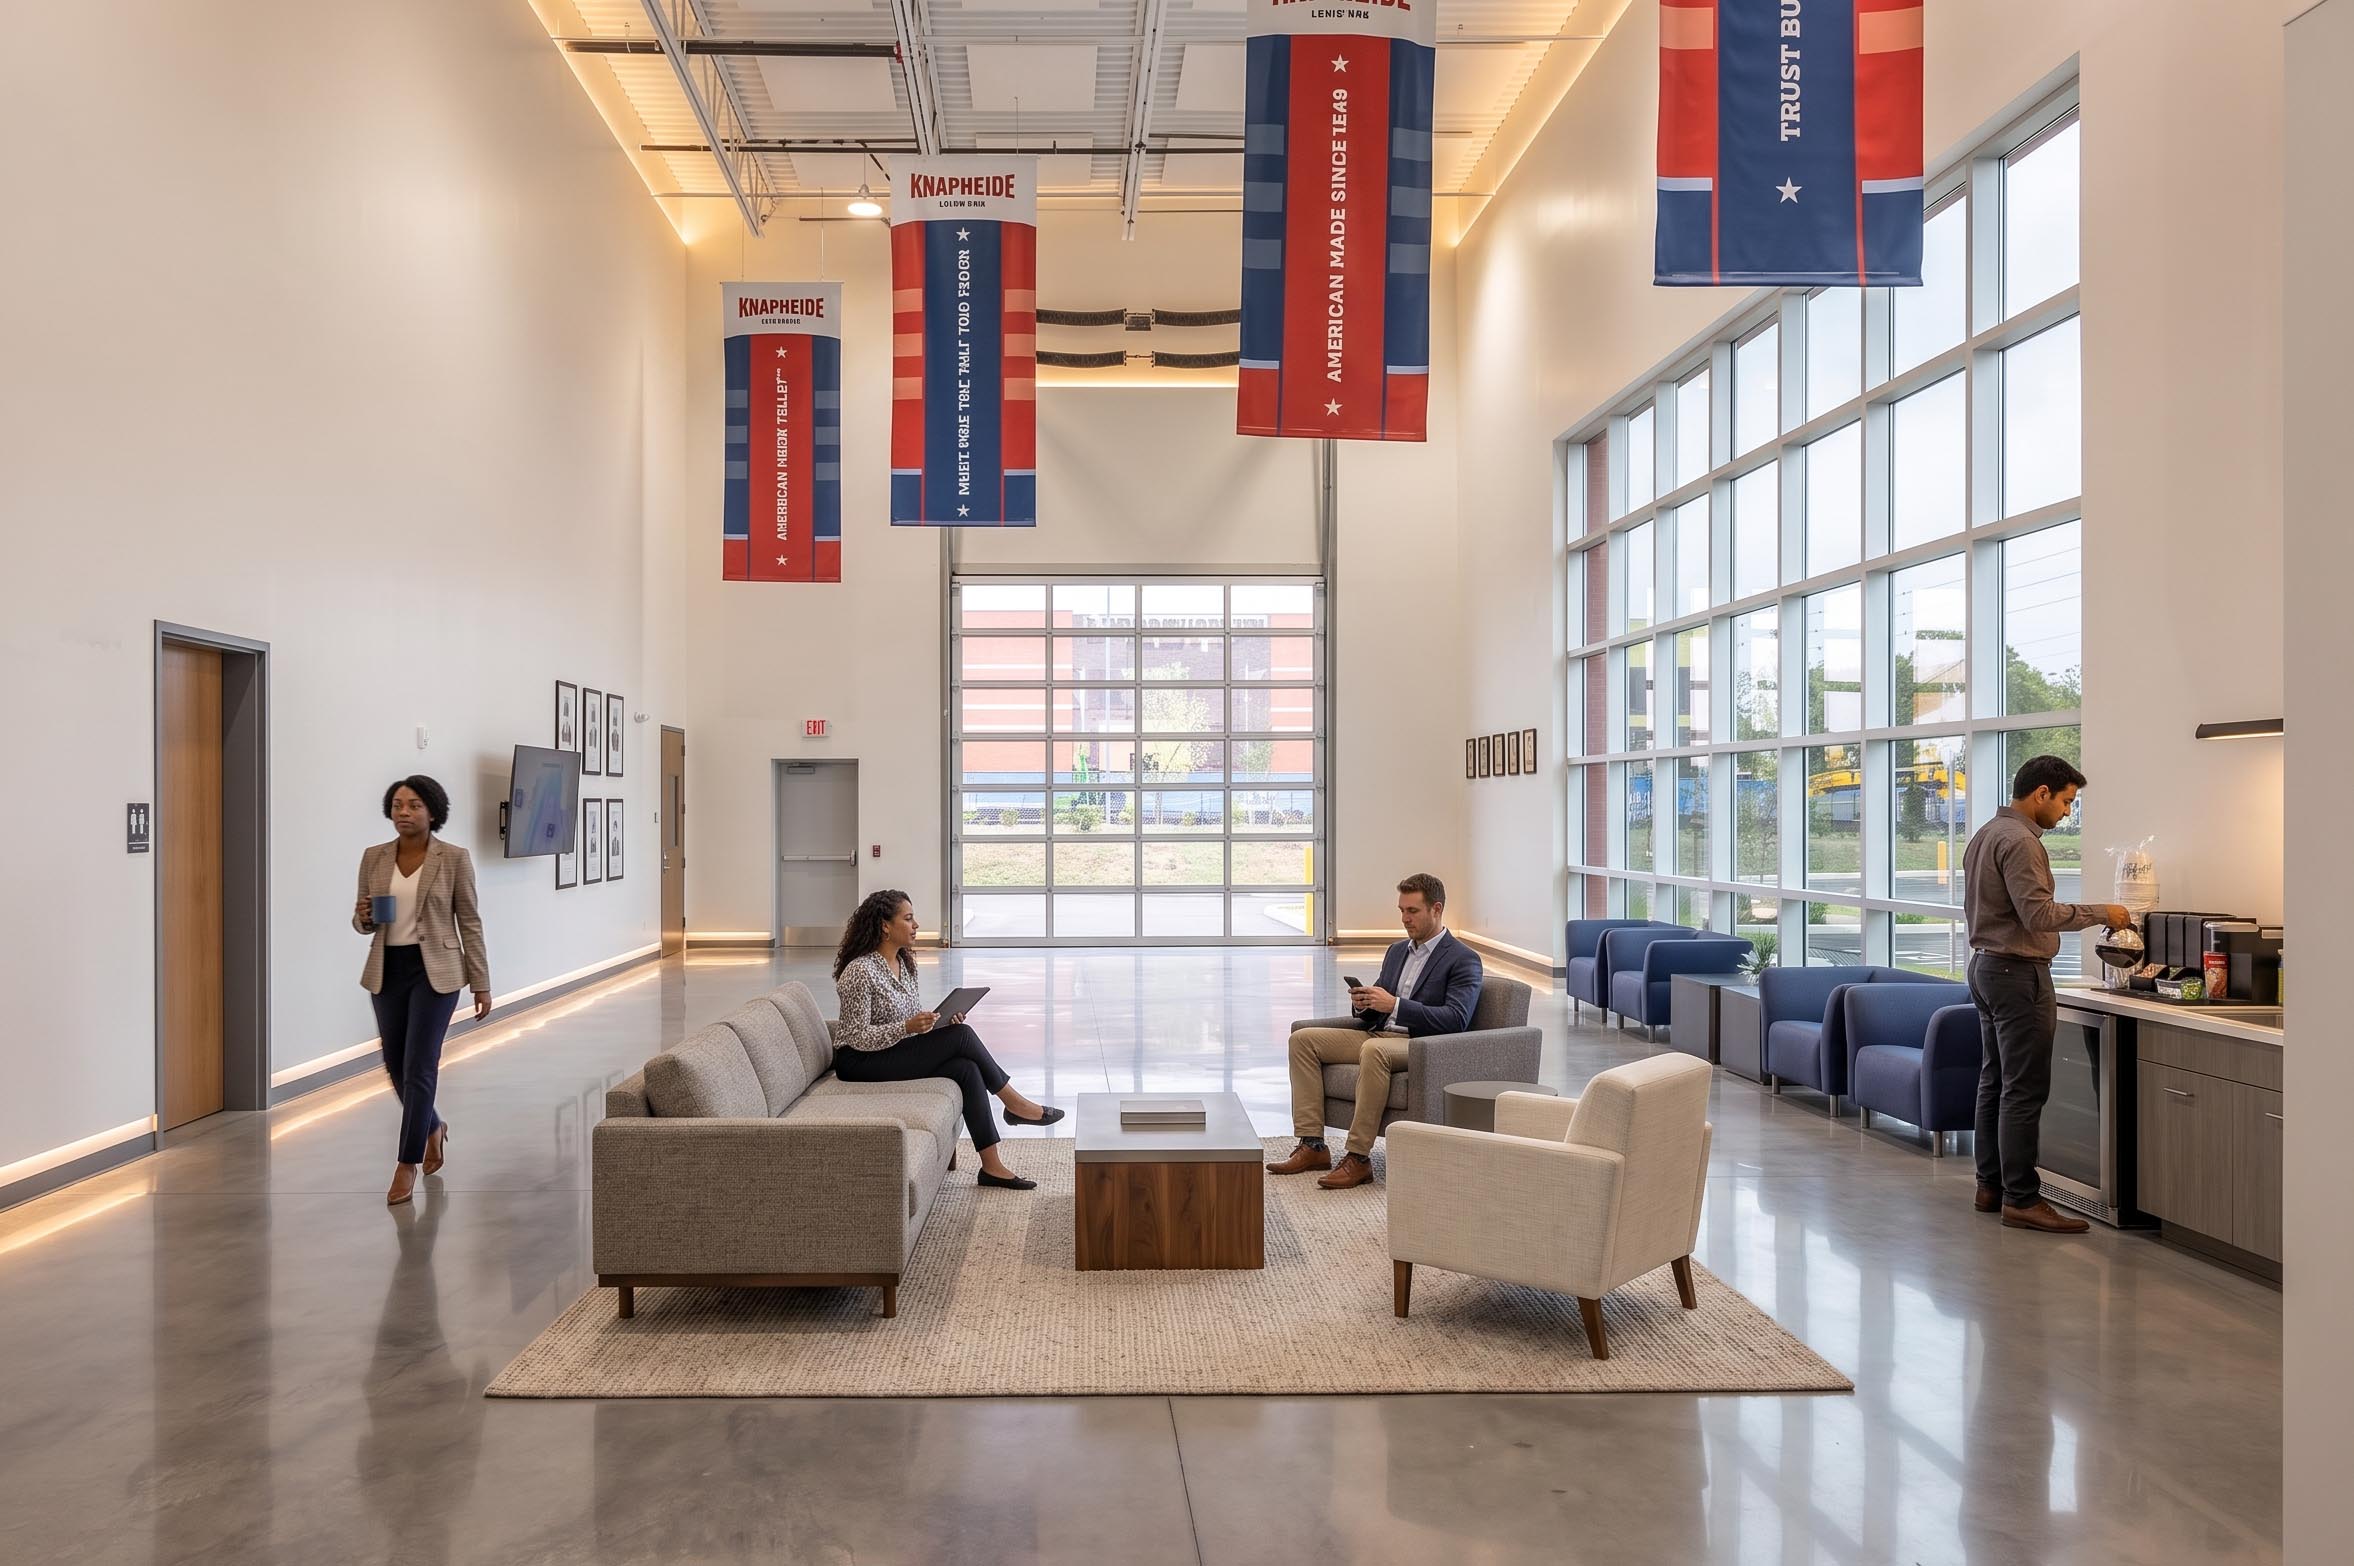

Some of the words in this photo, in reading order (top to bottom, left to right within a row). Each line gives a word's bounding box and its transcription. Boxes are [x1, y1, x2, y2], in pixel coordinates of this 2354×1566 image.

[1780, 45, 1801, 142] TRUST
[910, 173, 1016, 199] KNAPHEIDE
[1330, 140, 1347, 202] SINCE
[1329, 208, 1346, 269] MADE
[738, 297, 824, 319] KNAPHEIDE
[1326, 274, 1344, 383] AMERICAN
